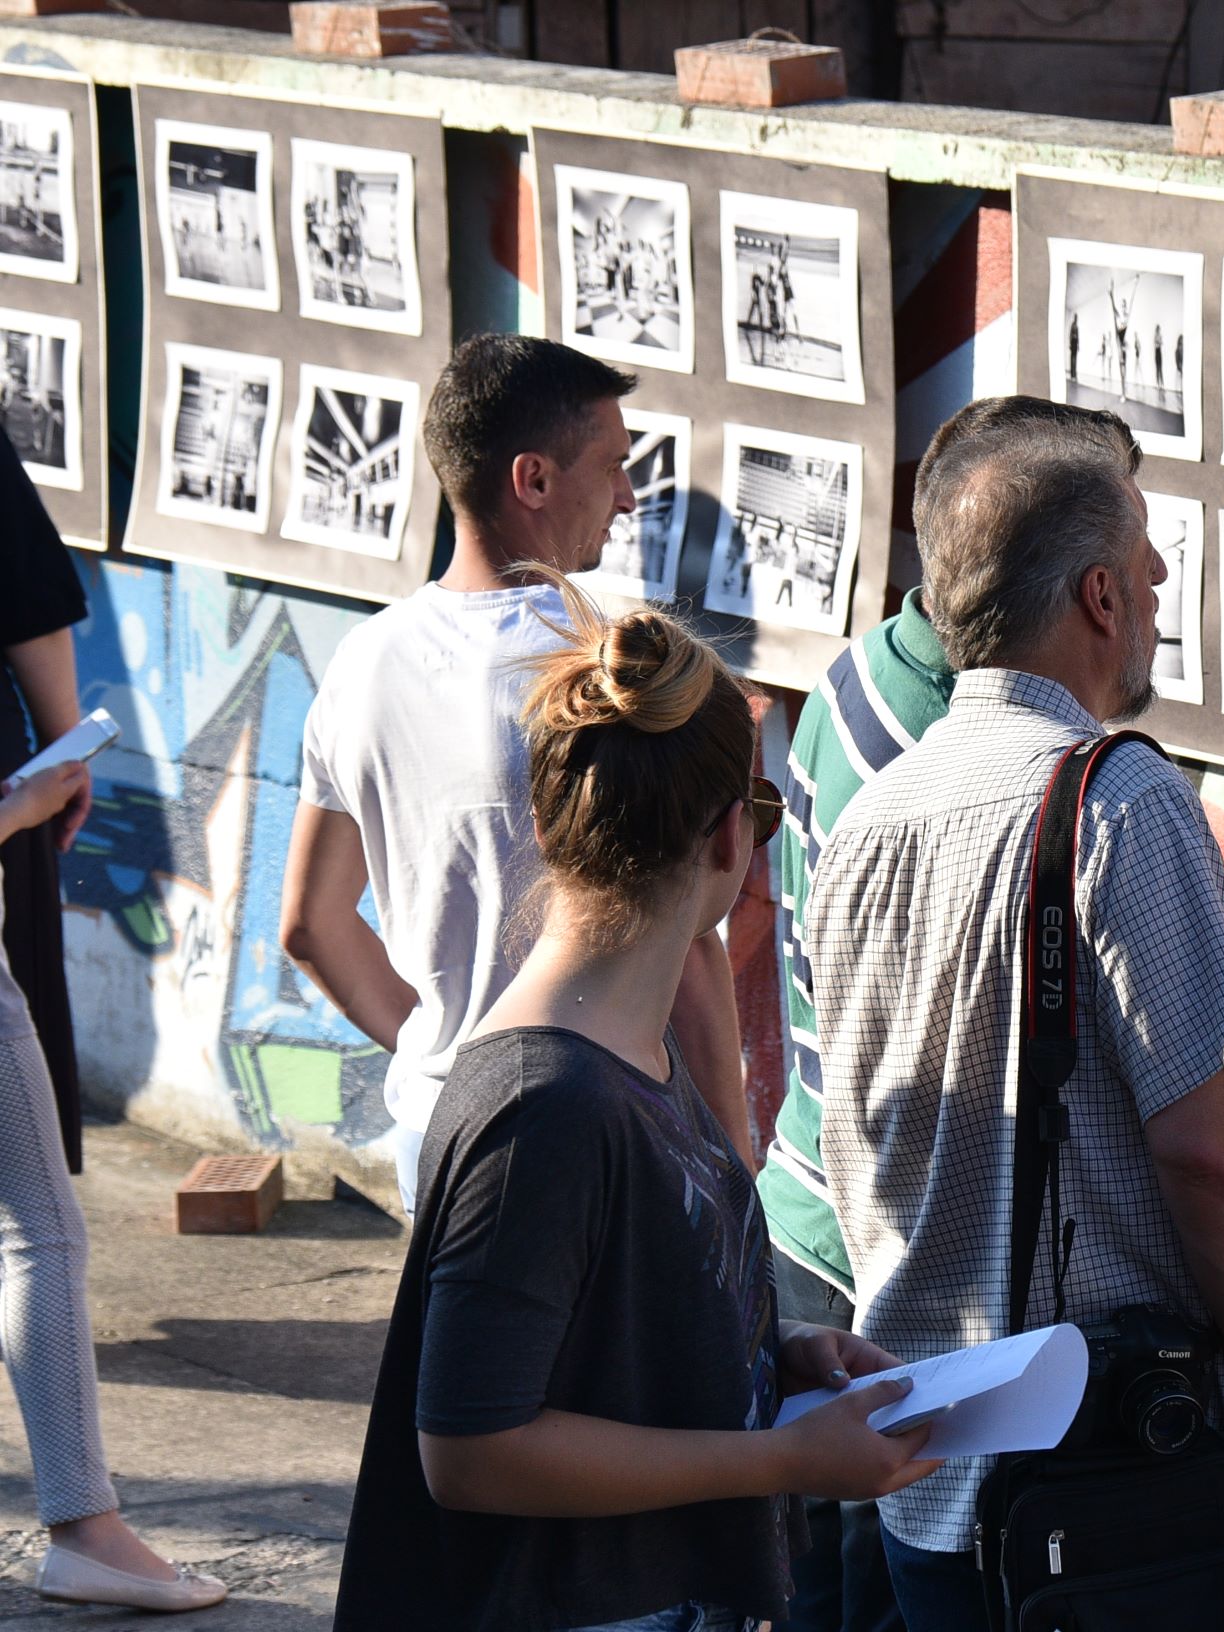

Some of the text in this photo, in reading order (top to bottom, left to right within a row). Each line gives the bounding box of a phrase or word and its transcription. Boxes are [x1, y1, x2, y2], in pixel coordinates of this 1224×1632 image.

[1042, 906, 1063, 1010] EOS 7D
[1158, 1349, 1191, 1359] Canon
